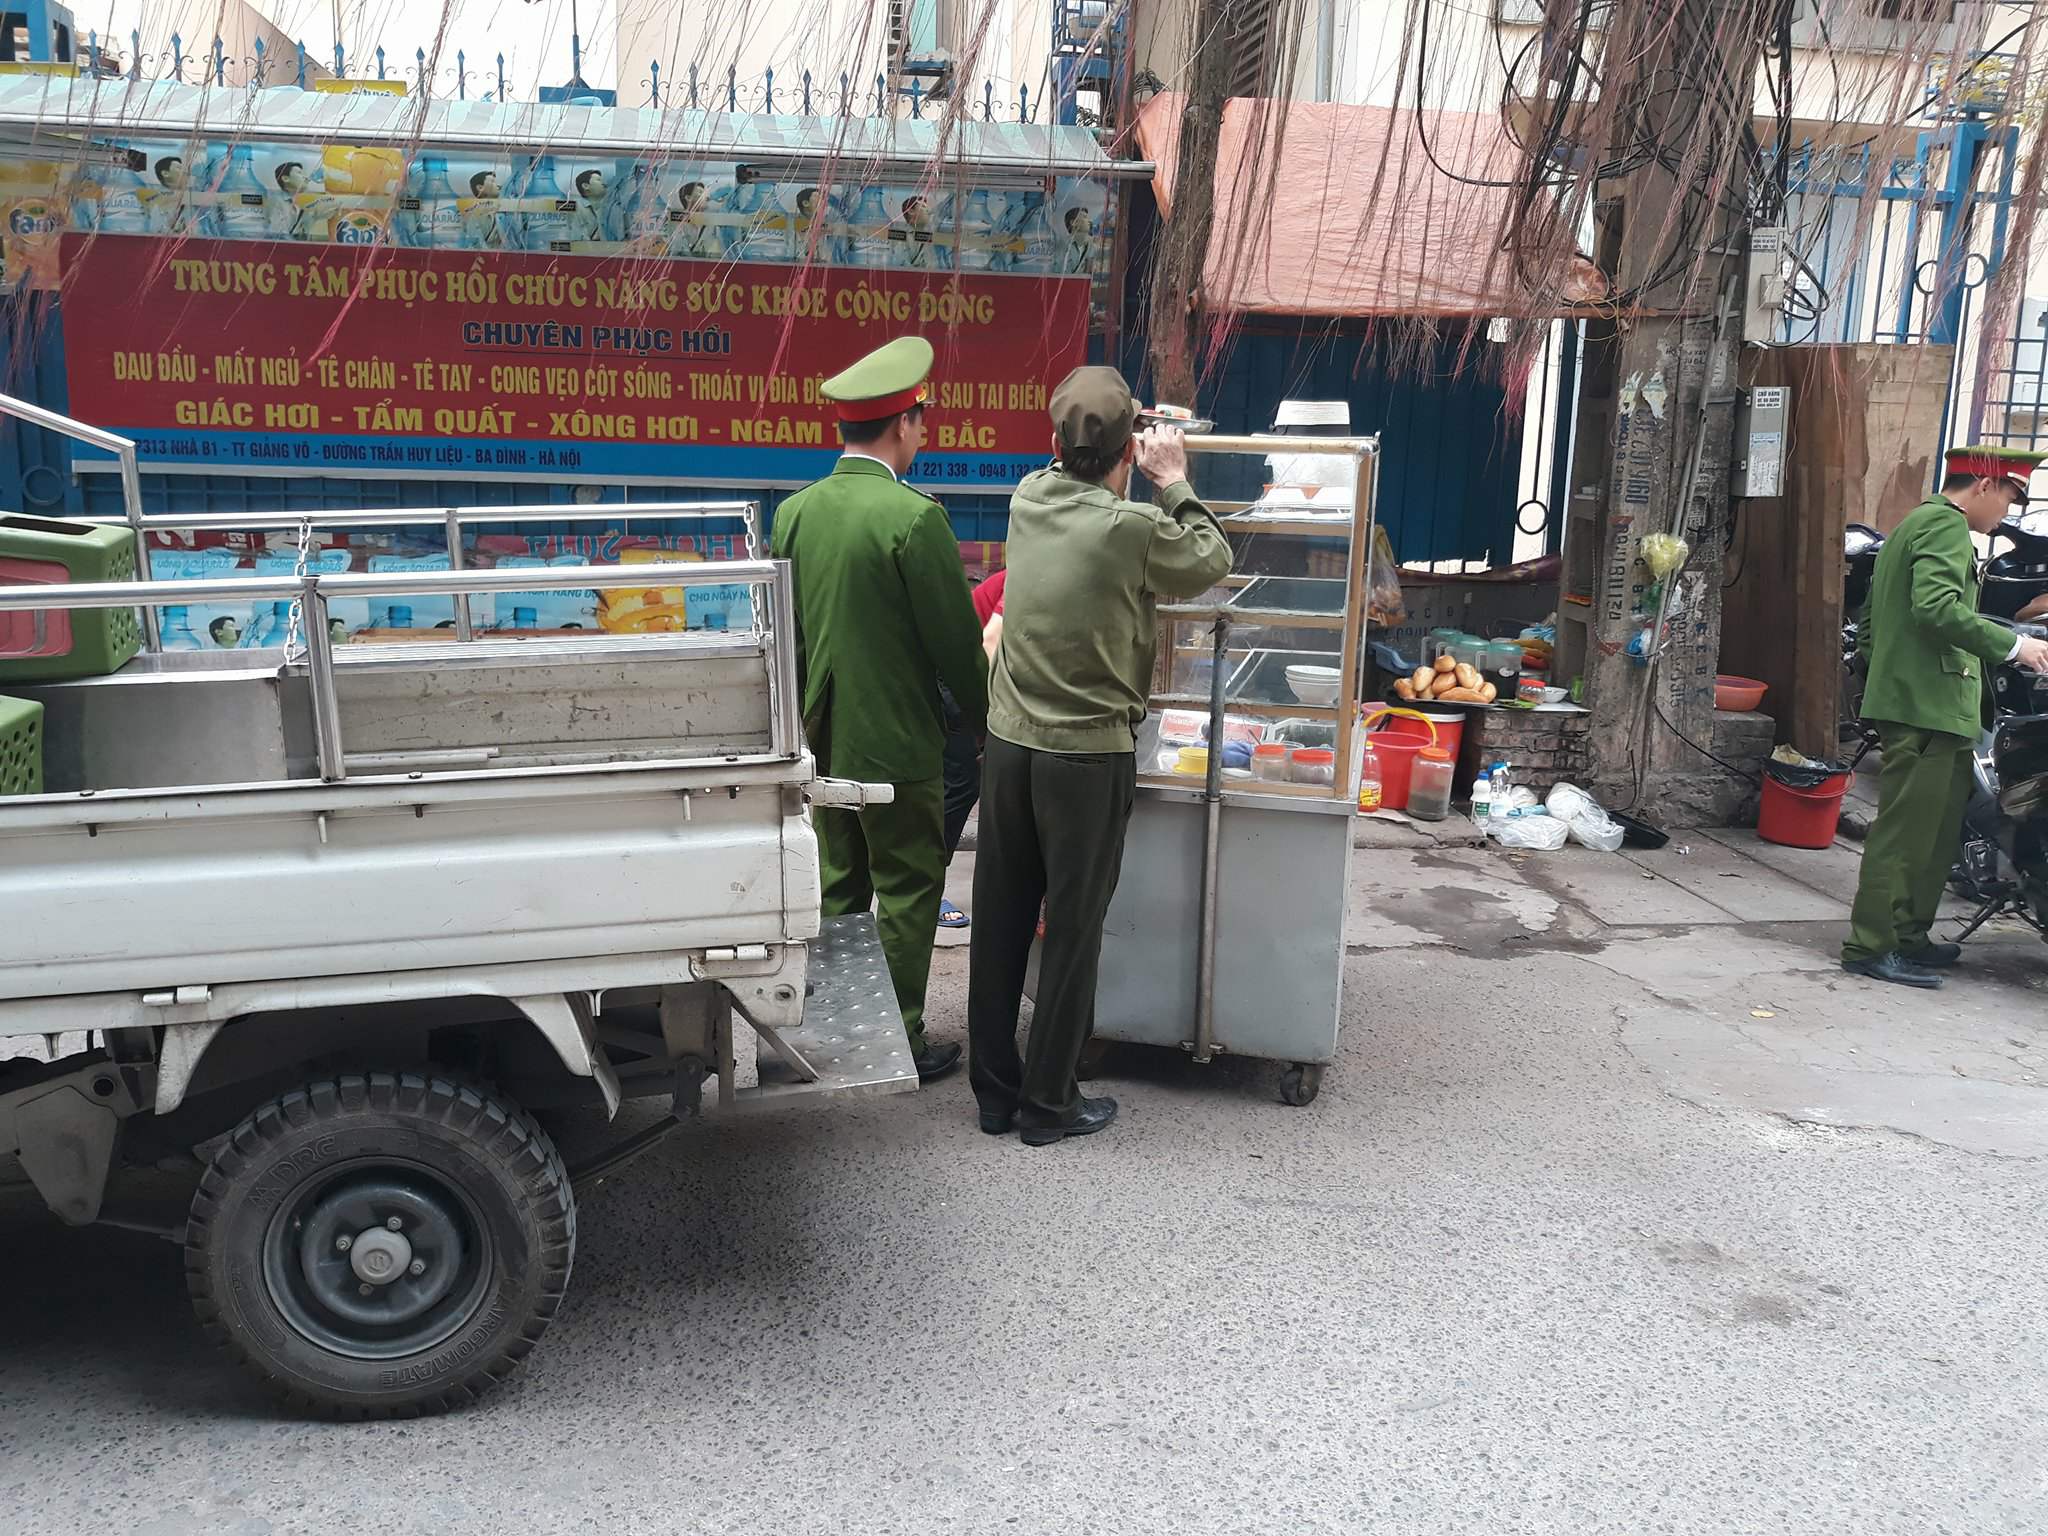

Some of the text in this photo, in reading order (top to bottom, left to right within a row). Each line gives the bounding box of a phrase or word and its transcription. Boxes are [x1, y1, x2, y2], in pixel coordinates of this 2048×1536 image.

[170, 259, 277, 295] TRUNG
[284, 256, 350, 297] TÂM
[357, 267, 438, 308] PHỤC
[446, 256, 498, 303] HỒI
[506, 265, 588, 308] CHỨC
[835, 280, 911, 328] CỘNG
[918, 278, 995, 325] ĐỒNG
[463, 320, 733, 356] CHUYÊN PHỤC HỒI
[113, 351, 153, 381] ĐAU
[157, 343, 197, 383] ĐẦU
[215, 346, 255, 385] MẤT
[261, 346, 300, 387] NGỦ
[318, 354, 340, 388] TÊ
[344, 355, 396, 389] CHÂN
[413, 358, 435, 391] TÊ
[439, 363, 473, 392] TAY
[490, 365, 541, 395] CONG
[545, 367, 579, 401] VẸO
[584, 364, 618, 403] CỘT
[623, 361, 672, 400] SỐNG
[689, 369, 743, 403] THOÁT
[769, 370, 798, 404] ĐĨA
[803, 372, 835, 411] ĐỆ
[940, 383, 973, 409] SAU
[978, 383, 1003, 411] TAI
[1008, 375, 1046, 411] BIẾN
[175, 397, 253, 427] GIÁC
[264, 403, 319, 429] HƠI
[352, 398, 424, 432] TẨM
[434, 403, 517, 436] QUẤT
[549, 408, 637, 439] XÔNG
[647, 415, 699, 441] HƠI
[730, 416, 822, 445] NGÂM
[938, 419, 997, 448] BẮC
[202, 442, 218, 456] B1
[231, 443, 245, 457] TT
[407, 447, 431, 462] HUY
[435, 446, 463, 466] LIỆU
[475, 450, 493, 464] BA
[538, 448, 555, 466] HÀ
[559, 450, 581, 469] NỘI
[923, 462, 944, 477] 221
[947, 463, 969, 477] 338
[979, 464, 1007, 479] 0948
[688, 591, 710, 602] CHO
